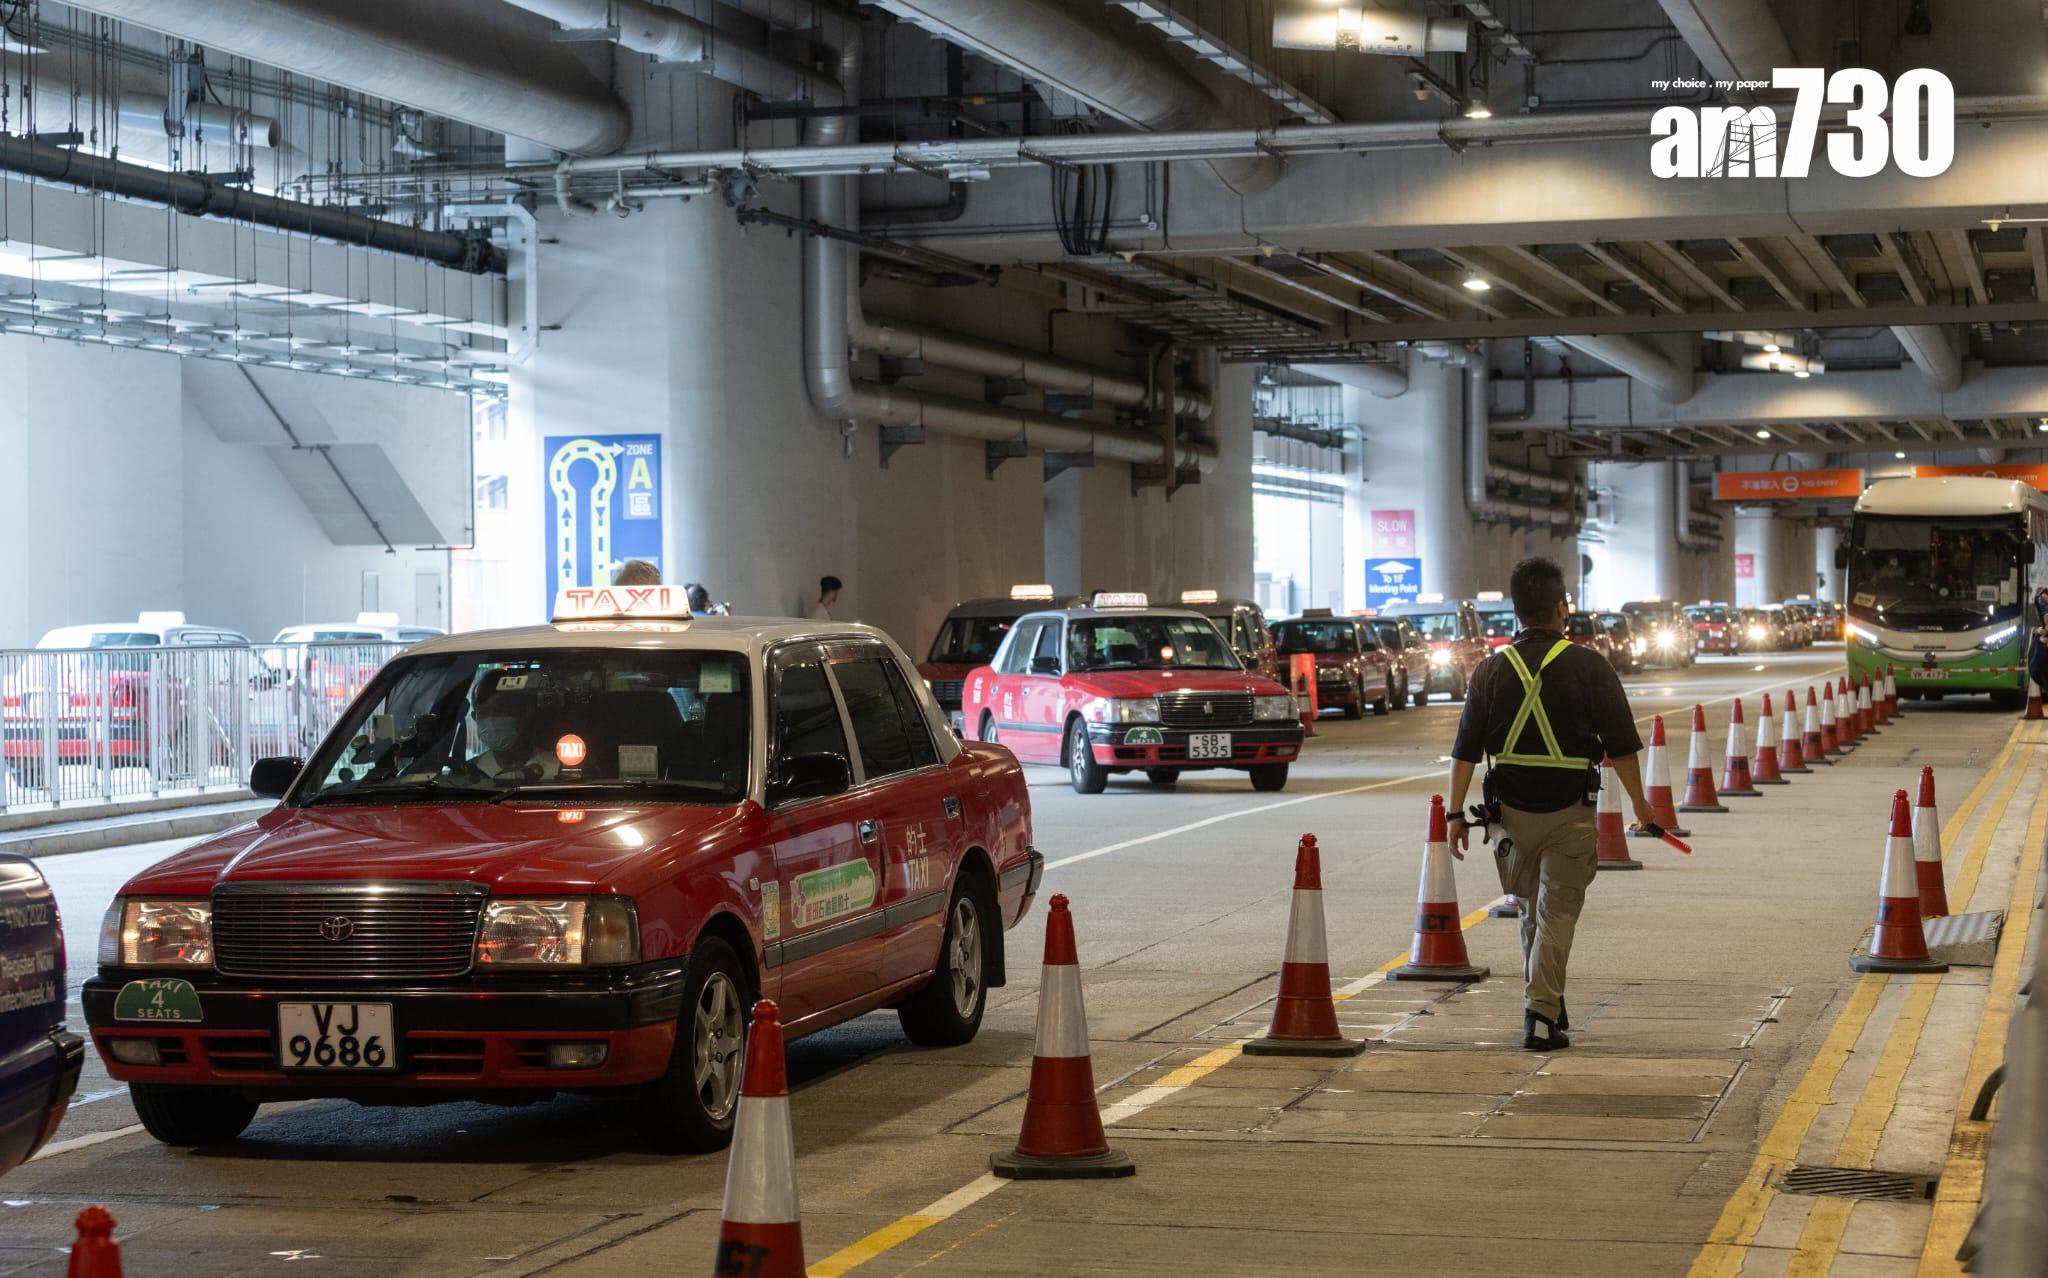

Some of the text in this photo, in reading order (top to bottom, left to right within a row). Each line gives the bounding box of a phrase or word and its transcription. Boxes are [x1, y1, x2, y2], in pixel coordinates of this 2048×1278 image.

[626, 444, 654, 455] ZONE
[628, 457, 653, 489] A
[629, 492, 653, 516] 區
[1377, 520, 1407, 532] SLOW
[1369, 584, 1418, 596] Meeting Point
[566, 588, 670, 612] TAXI
[1201, 735, 1219, 746] SB
[559, 742, 583, 758] TAXI
[1192, 746, 1228, 758] 5395
[908, 856, 929, 890] TAXI
[1, 950, 55, 982] Register Now
[151, 990, 165, 1008] 4
[137, 1008, 181, 1019] SEATS
[312, 1004, 359, 1036] VJ
[289, 1034, 386, 1067] 9686
